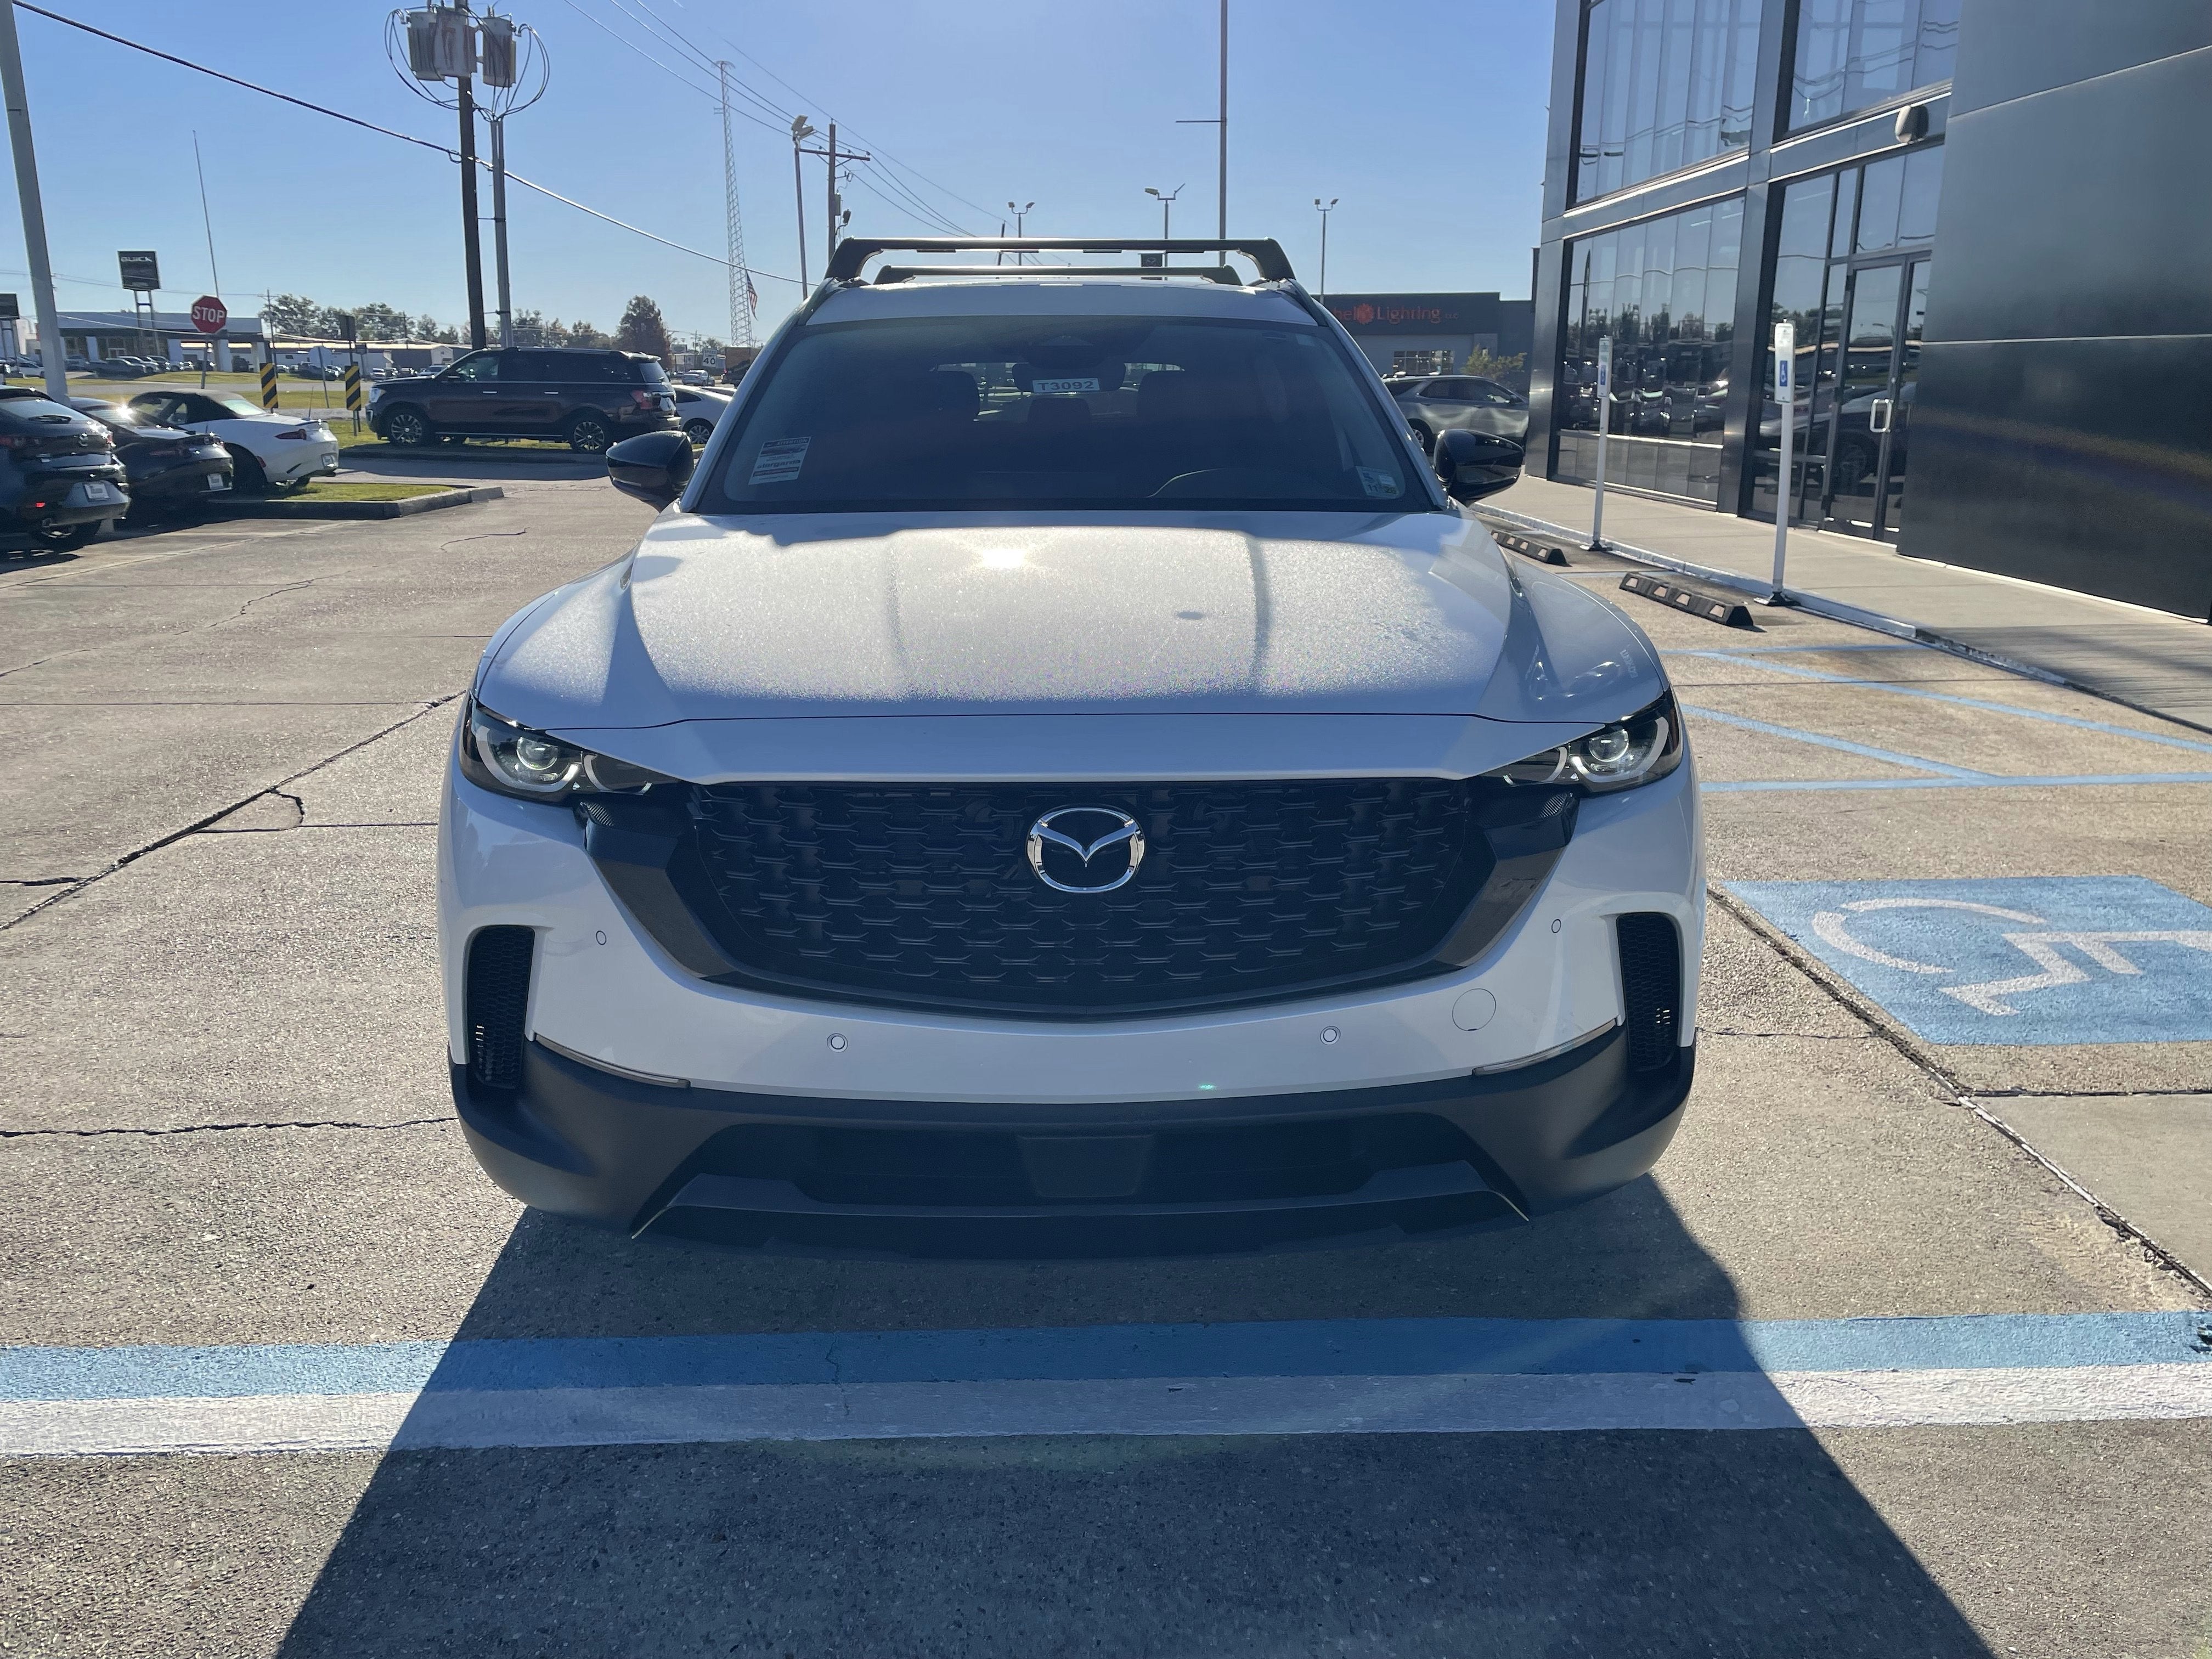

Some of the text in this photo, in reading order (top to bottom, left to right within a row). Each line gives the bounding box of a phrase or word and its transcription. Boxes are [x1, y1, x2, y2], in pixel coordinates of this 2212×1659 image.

[192, 306, 225, 323] STOP
[1377, 306, 1441, 324] Lighting
[1037, 381, 1094, 391] T3092
